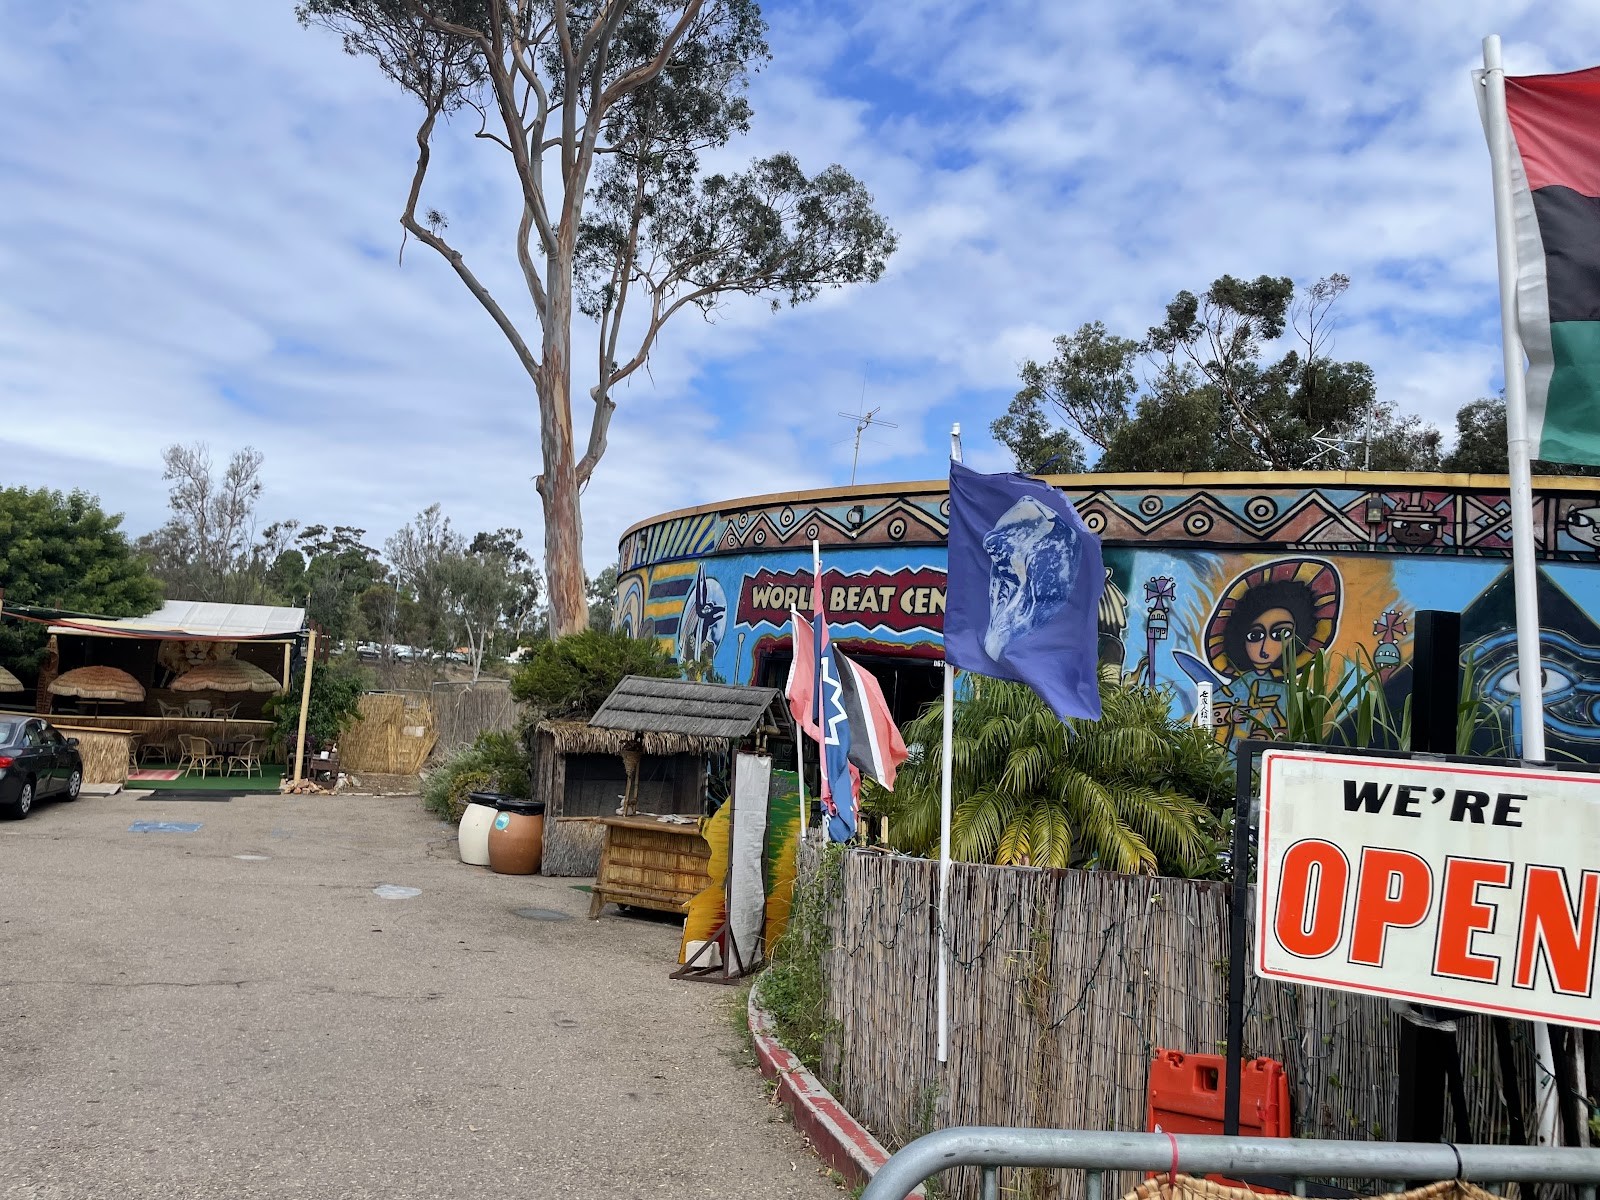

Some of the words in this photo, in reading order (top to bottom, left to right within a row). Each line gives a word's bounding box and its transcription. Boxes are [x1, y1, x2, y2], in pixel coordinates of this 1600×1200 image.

[829, 585, 897, 613] BEAT
[1343, 780, 1528, 827] WE'RE
[1274, 838, 1600, 998] OPEN
